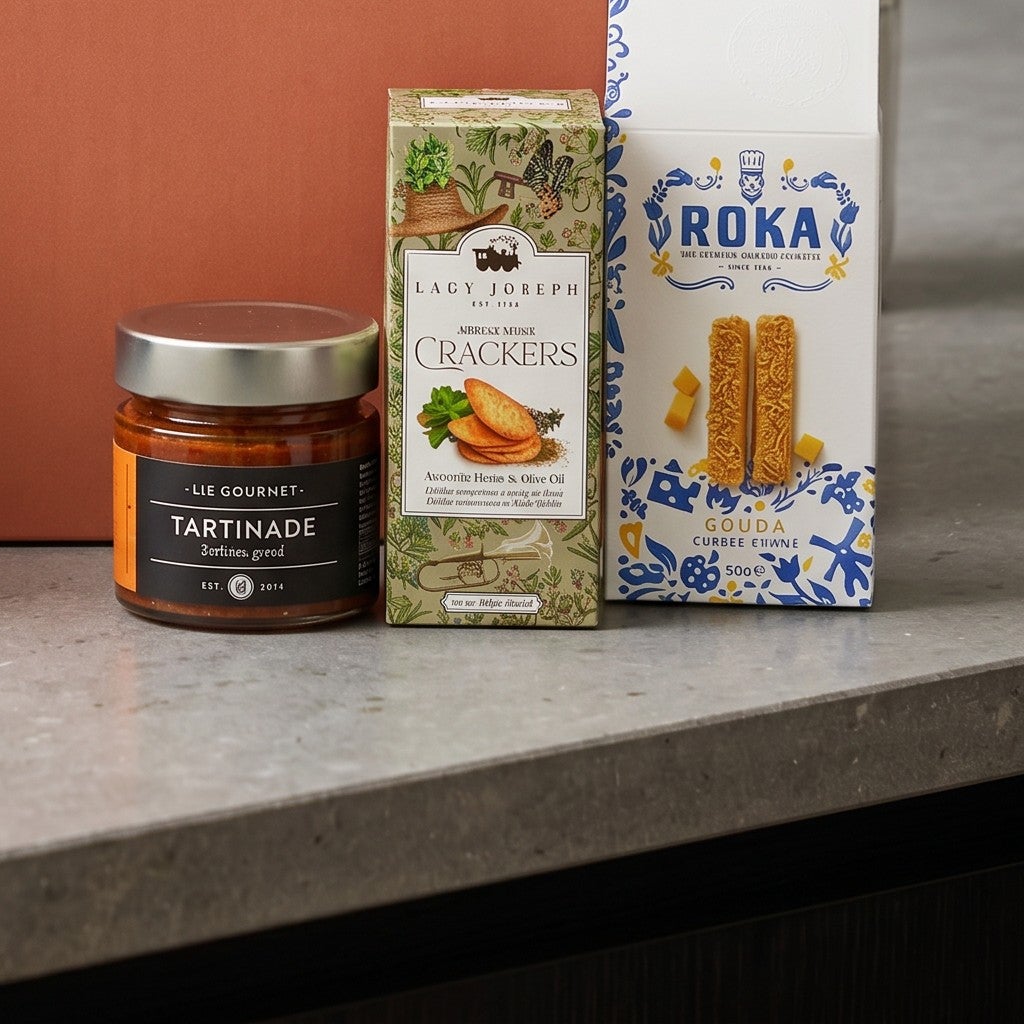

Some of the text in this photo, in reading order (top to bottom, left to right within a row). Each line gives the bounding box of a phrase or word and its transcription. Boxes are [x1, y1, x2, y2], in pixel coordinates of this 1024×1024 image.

[680, 205, 822, 249] ROKA
[414, 335, 578, 372] CRACKERS
[521, 473, 547, 484] Olive
[549, 473, 565, 485] Oil
[220, 484, 298, 498] GOURNET
[170, 514, 316, 540] TARTINADE
[705, 517, 785, 534] GOUDA
[693, 535, 745, 548] CURBEE
[201, 581, 284, 592] EST. 2014
